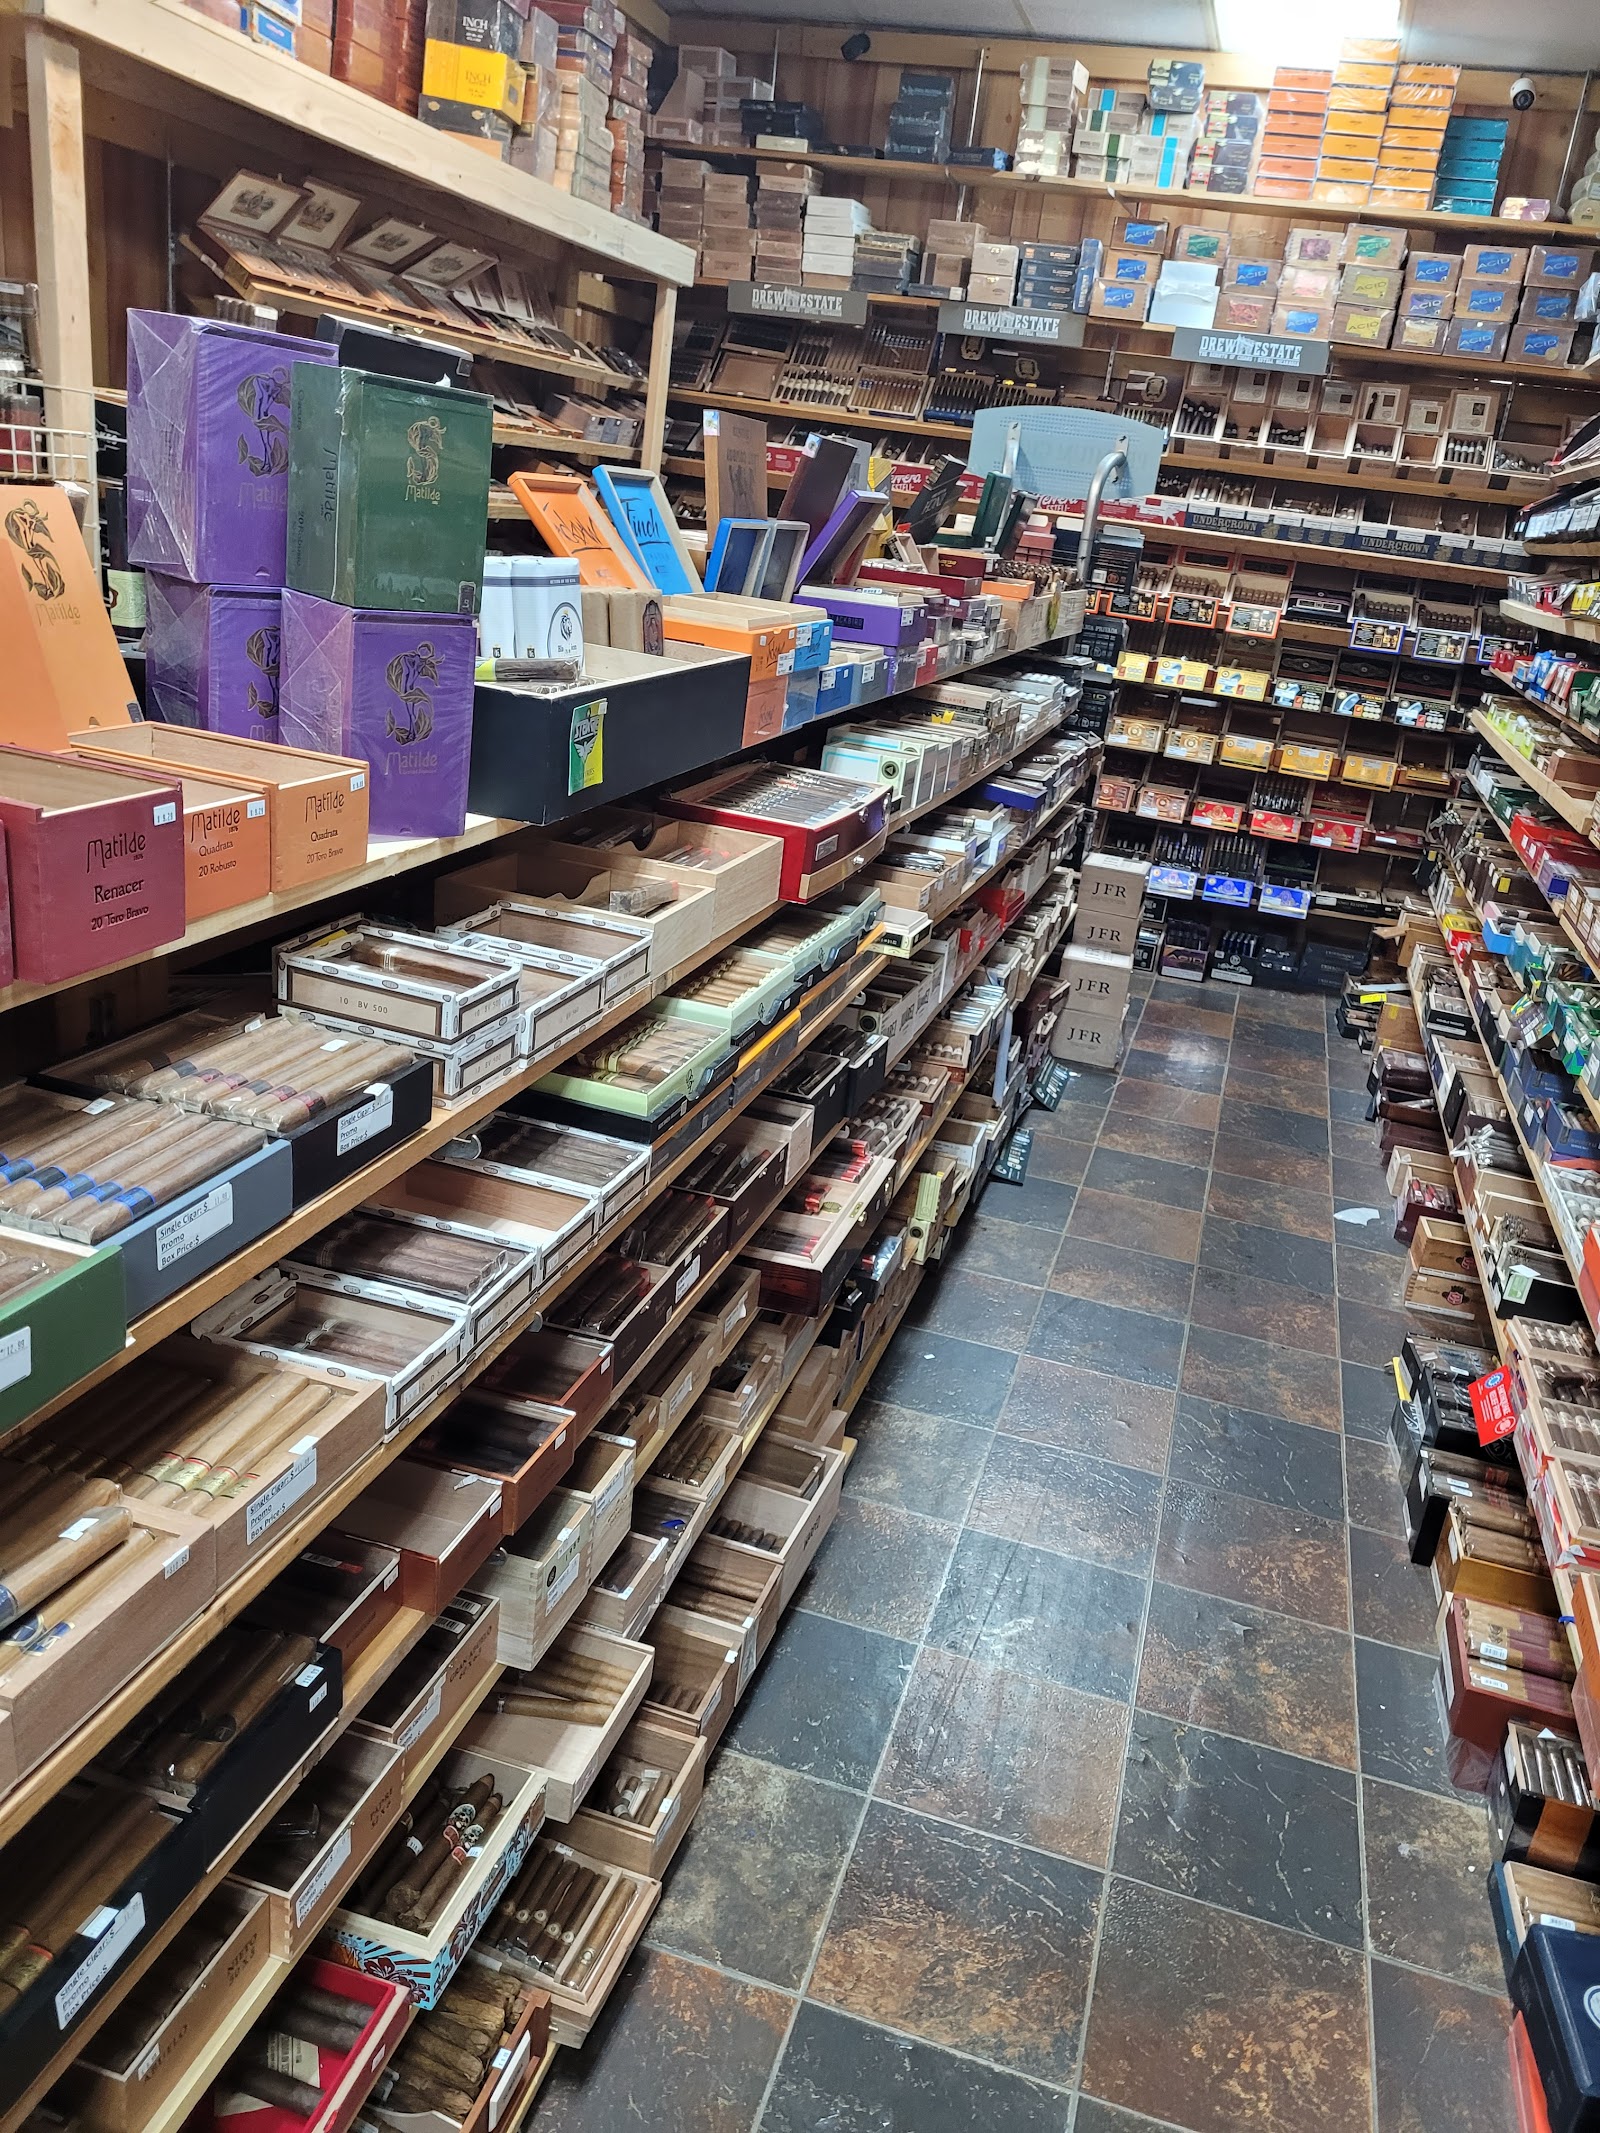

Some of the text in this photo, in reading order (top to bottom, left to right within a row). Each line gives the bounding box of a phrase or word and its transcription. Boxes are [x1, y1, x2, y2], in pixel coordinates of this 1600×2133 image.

[462, 15, 489, 31] INCH
[465, 70, 491, 84] INCH
[1126, 229, 1154, 240] ACID
[1357, 242, 1390, 253] ACID
[1117, 264, 1146, 275] ACID
[1416, 265, 1449, 277] ACID
[1478, 257, 1511, 269] ACID
[1544, 260, 1578, 272] ACID
[1237, 270, 1267, 281] ACID
[1355, 281, 1387, 292] ACID
[752, 288, 843, 310] DREW ESTATE
[1105, 293, 1134, 303] ACID
[1409, 300, 1443, 312] ACID
[1470, 295, 1503, 307] ACID
[1536, 301, 1569, 313] ACID
[964, 309, 1001, 326] DREW
[1014, 315, 1061, 332] ESTATE
[1288, 317, 1318, 328] ACID
[1349, 320, 1379, 331] ACID
[1200, 335, 1303, 360] DREW ESTATE
[1459, 334, 1492, 346] ACID
[1524, 339, 1557, 350] ACID
[322, 447, 338, 523] Matilde
[404, 484, 441, 503] Matilde
[1193, 515, 1258, 532] UNDERCROWN
[1362, 537, 1430, 554] UNDERCROWN
[35, 603, 81, 627] Matilde
[384, 751, 438, 775] Matilde
[305, 791, 345, 823] Matilde
[190, 808, 241, 843] Matilde
[310, 829, 339, 843] Quadrata
[87, 832, 147, 874] Matilde
[198, 840, 234, 858] Quadrata
[306, 847, 344, 865] 20 Toro Bravo
[198, 859, 237, 878] 20 Robusto
[94, 879, 144, 904] Renacer
[91, 905, 149, 931] 20 Toro Bravo
[1168, 953, 1204, 964] ACID
[339, 996, 388, 1014] 10 BV 500
[340, 1114, 356, 1128] Single
[357, 1107, 371, 1119] Cigar:
[340, 1126, 357, 1140] Promo
[340, 1143, 349, 1152] Box
[160, 1220, 181, 1239] Single
[183, 1208, 202, 1224] Cigar:
[161, 1233, 184, 1252] Promo
[161, 1253, 175, 1266] Box
[250, 1494, 269, 1515] Single
[271, 1476, 289, 1496] Cigar:
[250, 1504, 272, 1527] Promo
[250, 1526, 263, 1540] Box
[60, 1968, 85, 2000] Single
[86, 1940, 109, 1967] Cigar:
[62, 1975, 90, 2011] Promo
[65, 2002, 80, 2021] Box
